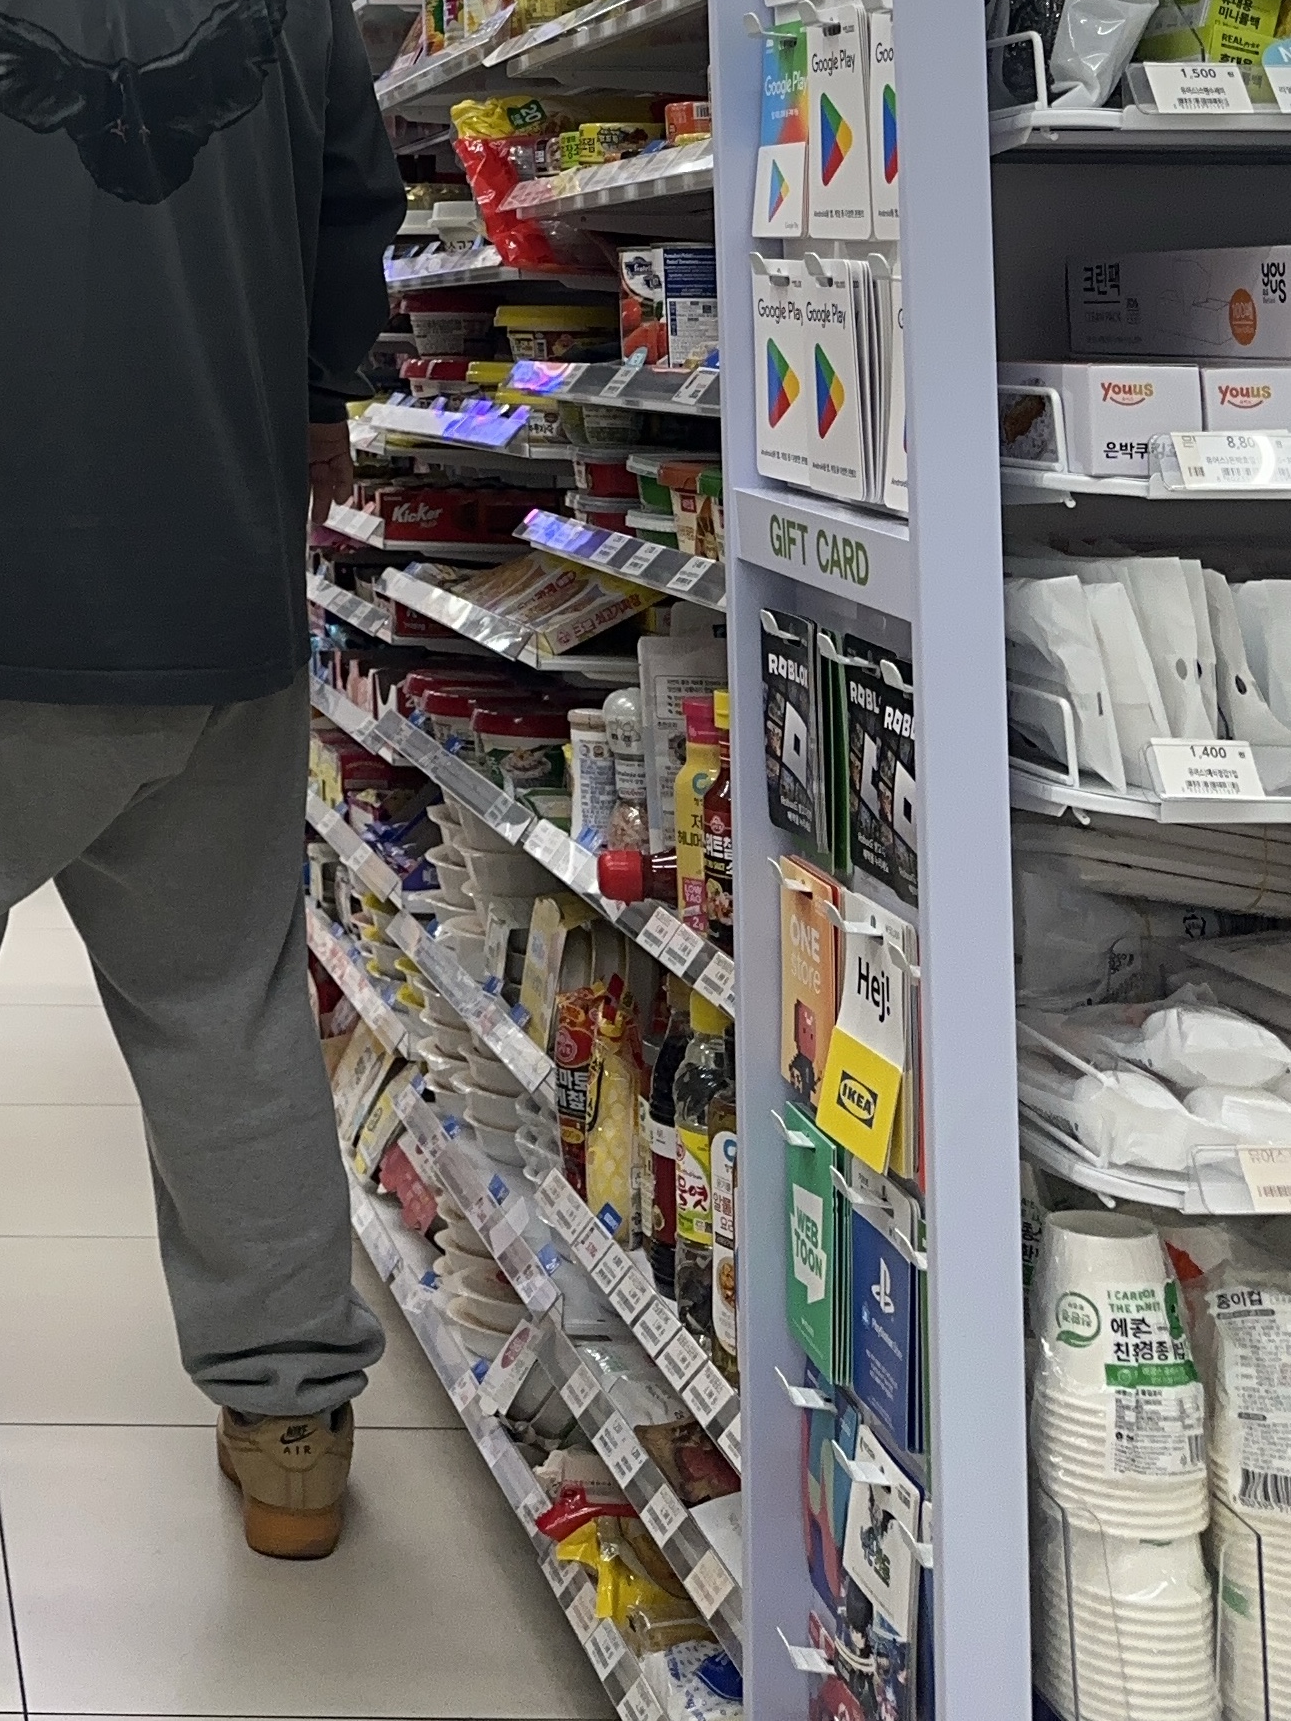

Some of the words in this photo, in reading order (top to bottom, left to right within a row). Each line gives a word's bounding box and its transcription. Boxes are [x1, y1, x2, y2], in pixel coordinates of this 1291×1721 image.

[812, 52, 839, 76] Google
[840, 49, 856, 73] Play
[875, 42, 893, 63] Goo
[1180, 68, 1217, 79] 1,500
[765, 75, 793, 100] Google
[758, 298, 787, 325] Google
[806, 302, 831, 329] Google
[832, 304, 846, 330] Play
[1100, 381, 1154, 403] youus
[1218, 384, 1272, 406] youus
[769, 513, 809, 566] GIFT
[815, 532, 870, 588] CARD
[1190, 746, 1227, 759] 1,400
[789, 913, 821, 965] ONE
[857, 955, 891, 1024] Hej!
[841, 1082, 875, 1118] IKEA
[795, 1204, 821, 1251] WEB
[794, 1227, 824, 1280] TOON
[1216, 1290, 1263, 1310] 종이컵
[283, 1445, 311, 1455] AIR
